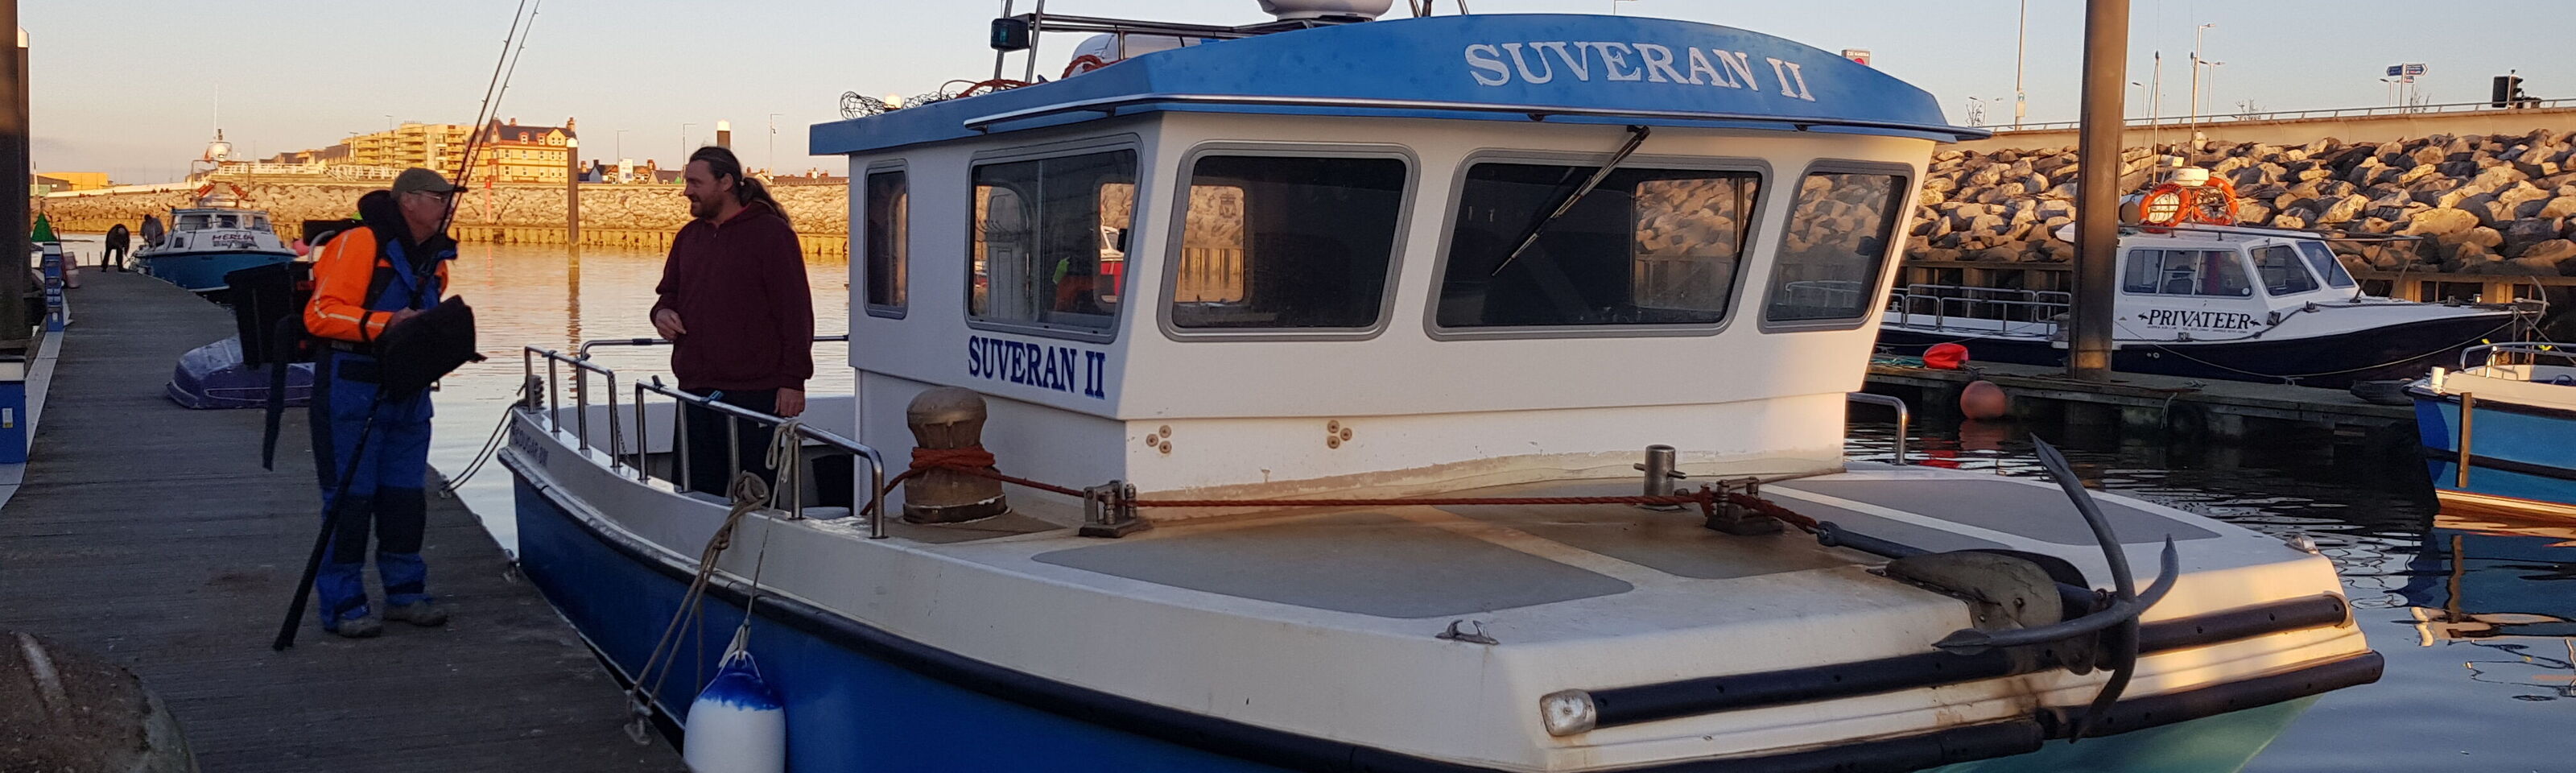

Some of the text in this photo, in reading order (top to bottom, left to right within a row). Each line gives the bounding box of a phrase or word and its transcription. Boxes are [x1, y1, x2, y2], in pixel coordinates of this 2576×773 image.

[1464, 41, 1816, 103] SUVERAN II
[2148, 309, 2251, 330] PRIVATEER
[968, 335, 1105, 400] SUVERAN II
